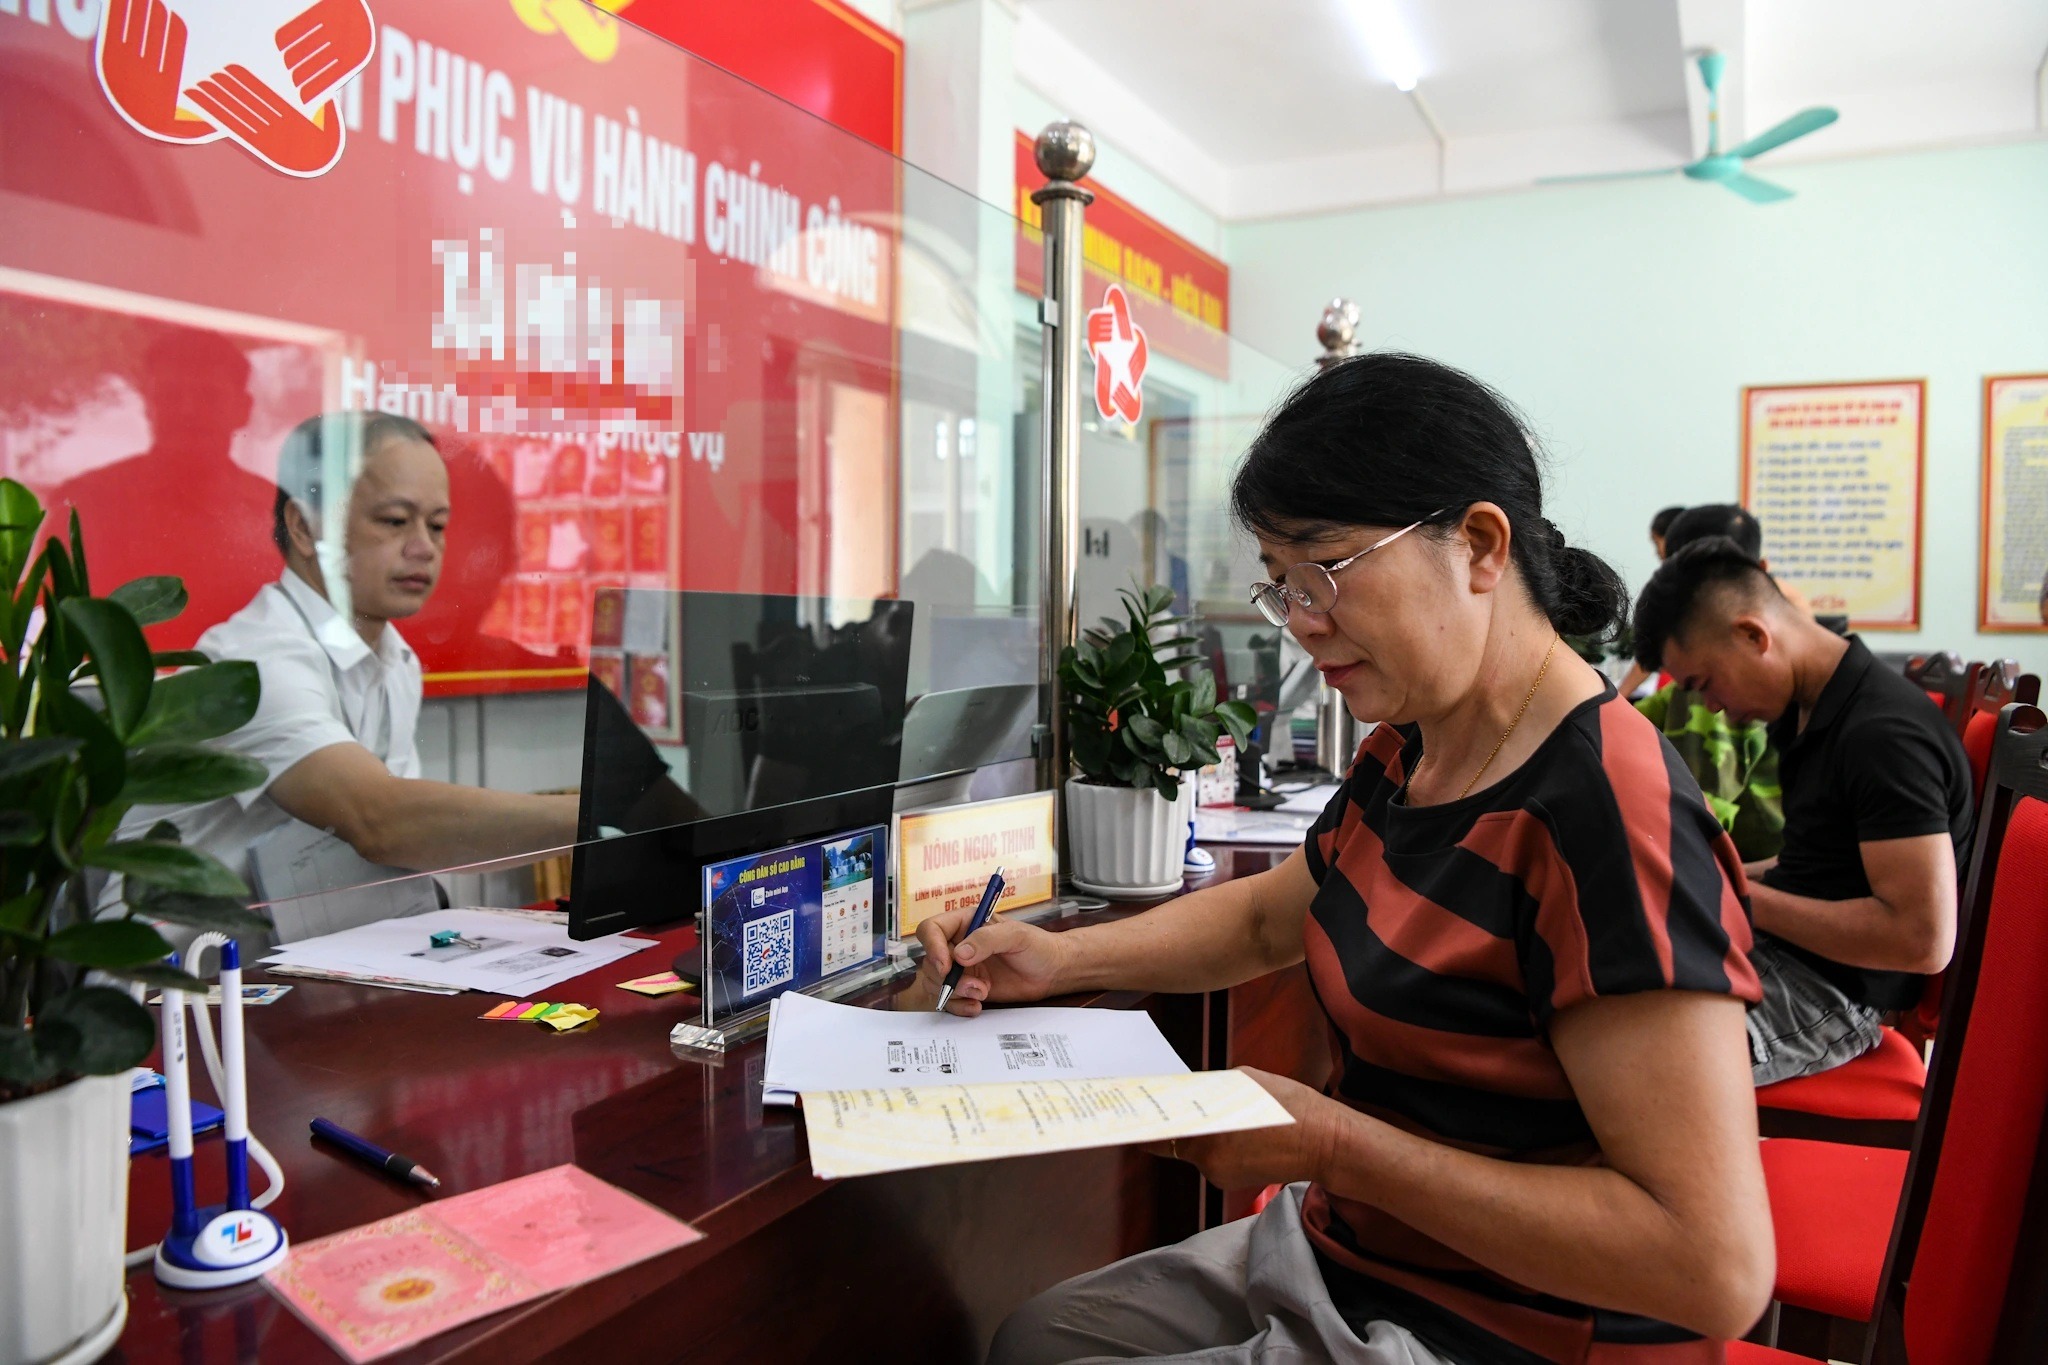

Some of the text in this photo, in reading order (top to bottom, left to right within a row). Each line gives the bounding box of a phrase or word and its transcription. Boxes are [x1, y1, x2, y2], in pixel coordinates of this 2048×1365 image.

[378, 23, 515, 196] PHỤC
[526, 84, 584, 228] VỤ
[593, 104, 697, 246] HÀNH
[704, 160, 801, 280] CHÍNH
[806, 194, 879, 308] CÔNG
[923, 825, 1036, 872] NÔNG NGỌC THỊNH
[739, 869, 755, 884] CÔNG
[756, 864, 769, 879] DÂN
[769, 860, 778, 876] SỐ
[778, 860, 790, 873] CAO
[944, 898, 957, 912] ĐT:
